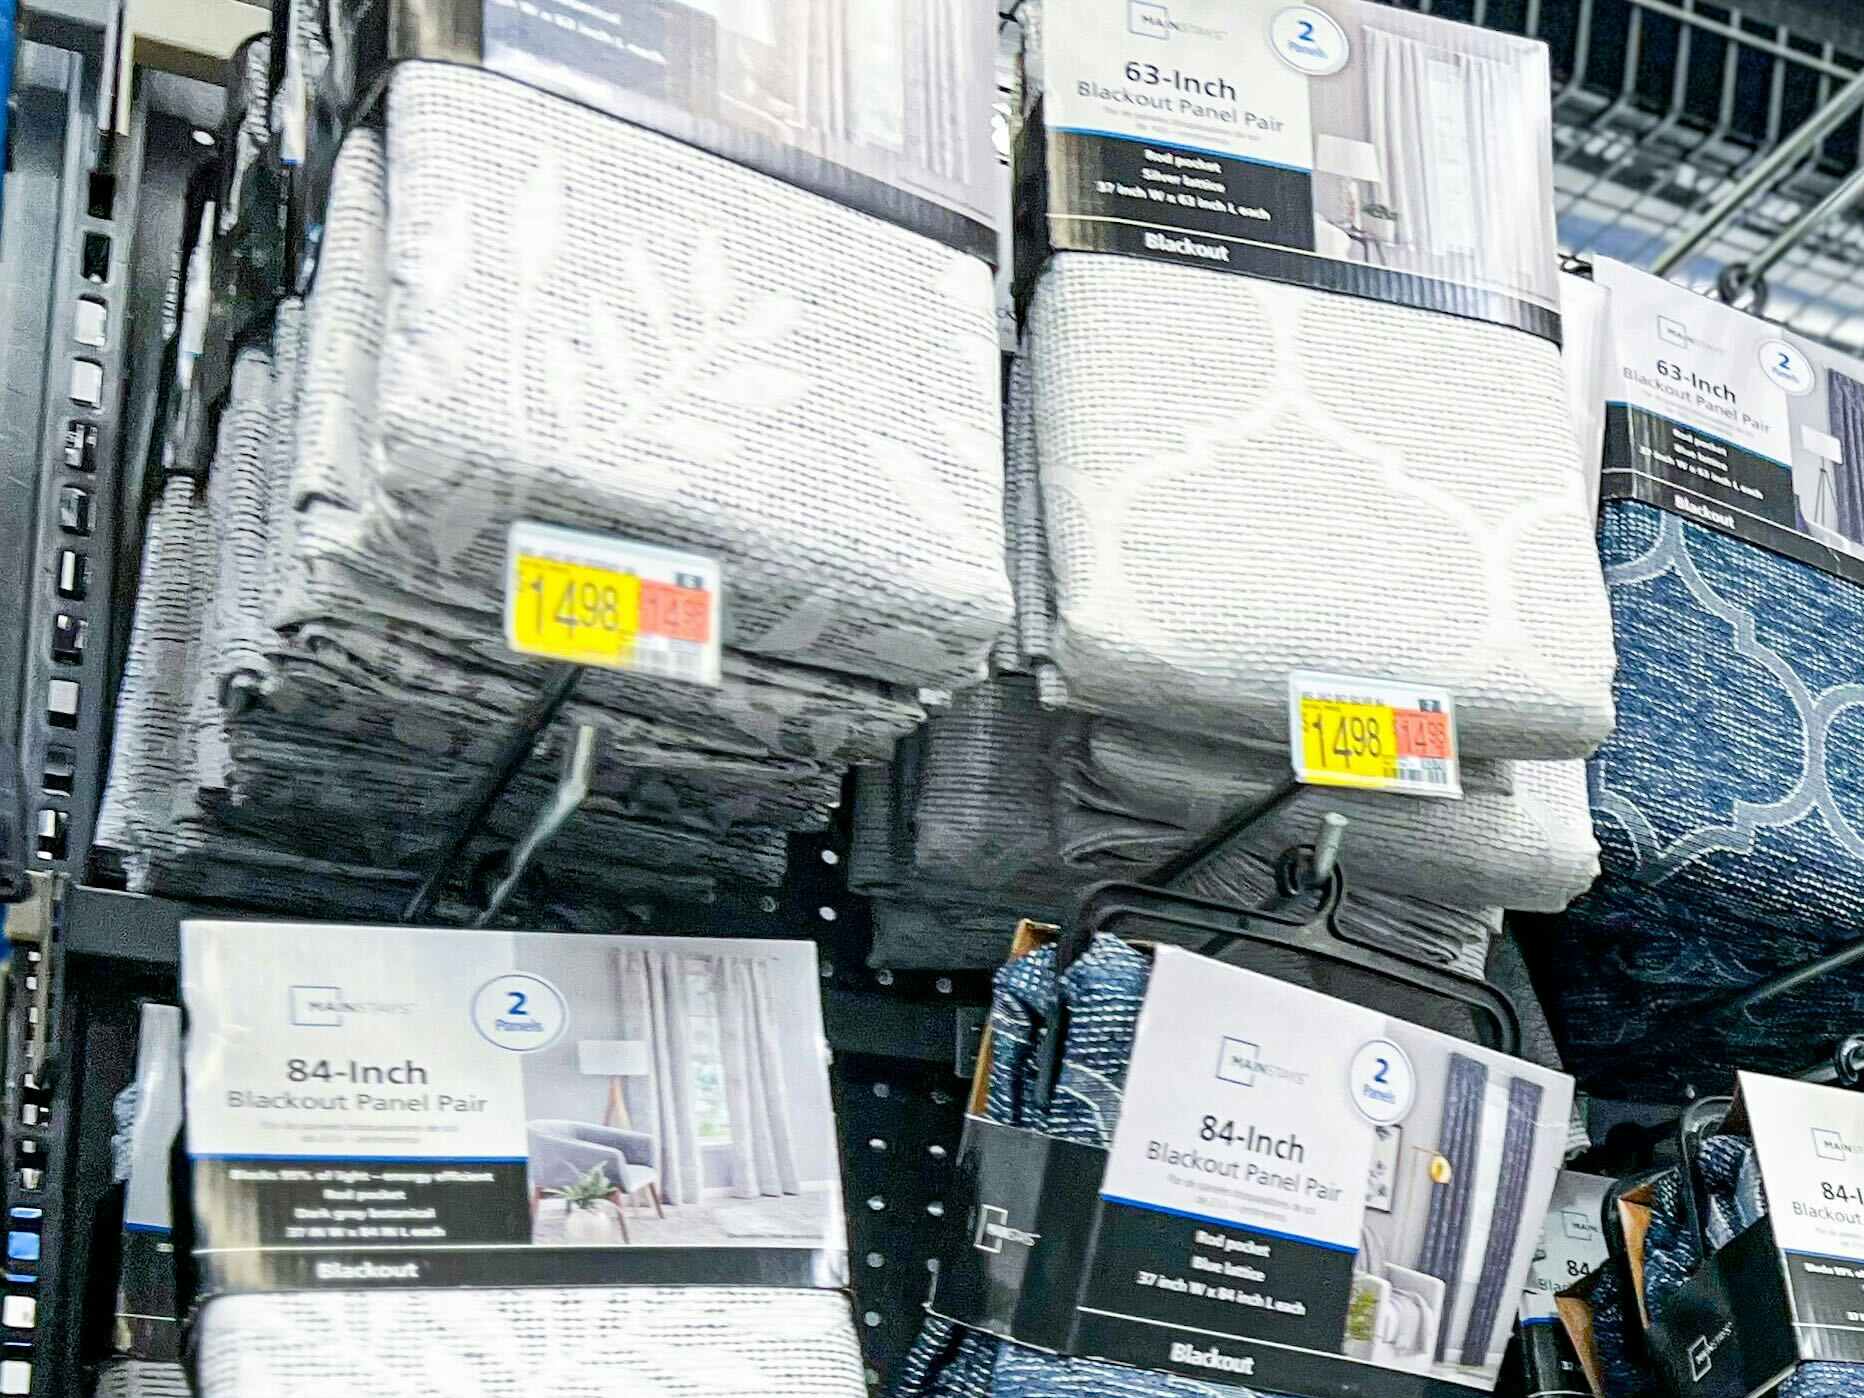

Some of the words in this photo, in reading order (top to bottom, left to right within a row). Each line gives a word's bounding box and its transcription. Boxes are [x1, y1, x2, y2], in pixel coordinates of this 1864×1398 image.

[1298, 20, 1314, 42] 2
[1125, 61, 1236, 101] 63-Inch
[1077, 80, 1173, 111] Blackout
[1180, 99, 1237, 123] Panel
[1245, 110, 1284, 132] Pair
[1144, 231, 1230, 262] Blackout
[1778, 353, 1791, 369] 2
[1656, 360, 1736, 404] 63-Inch
[1624, 367, 1691, 402] Blackout
[1696, 396, 1737, 423] Panel
[1742, 413, 1770, 433] Pair
[1674, 495, 1735, 529] Blackout
[507, 992, 528, 1015] 2
[286, 1059, 428, 1085] 84-Inch
[1373, 1057, 1390, 1083] 2
[227, 1090, 348, 1111] Blackout
[356, 1094, 428, 1112] Panel
[438, 1094, 488, 1112] Pair
[1200, 1114, 1304, 1163] 84-Inch
[1147, 1140, 1240, 1179] Blackout
[1247, 1163, 1300, 1192] Panel
[1307, 1177, 1342, 1201] Pair
[1793, 1201, 1862, 1225] Blackout
[316, 1261, 419, 1278] Blackout
[1170, 1342, 1255, 1375] Blackout
